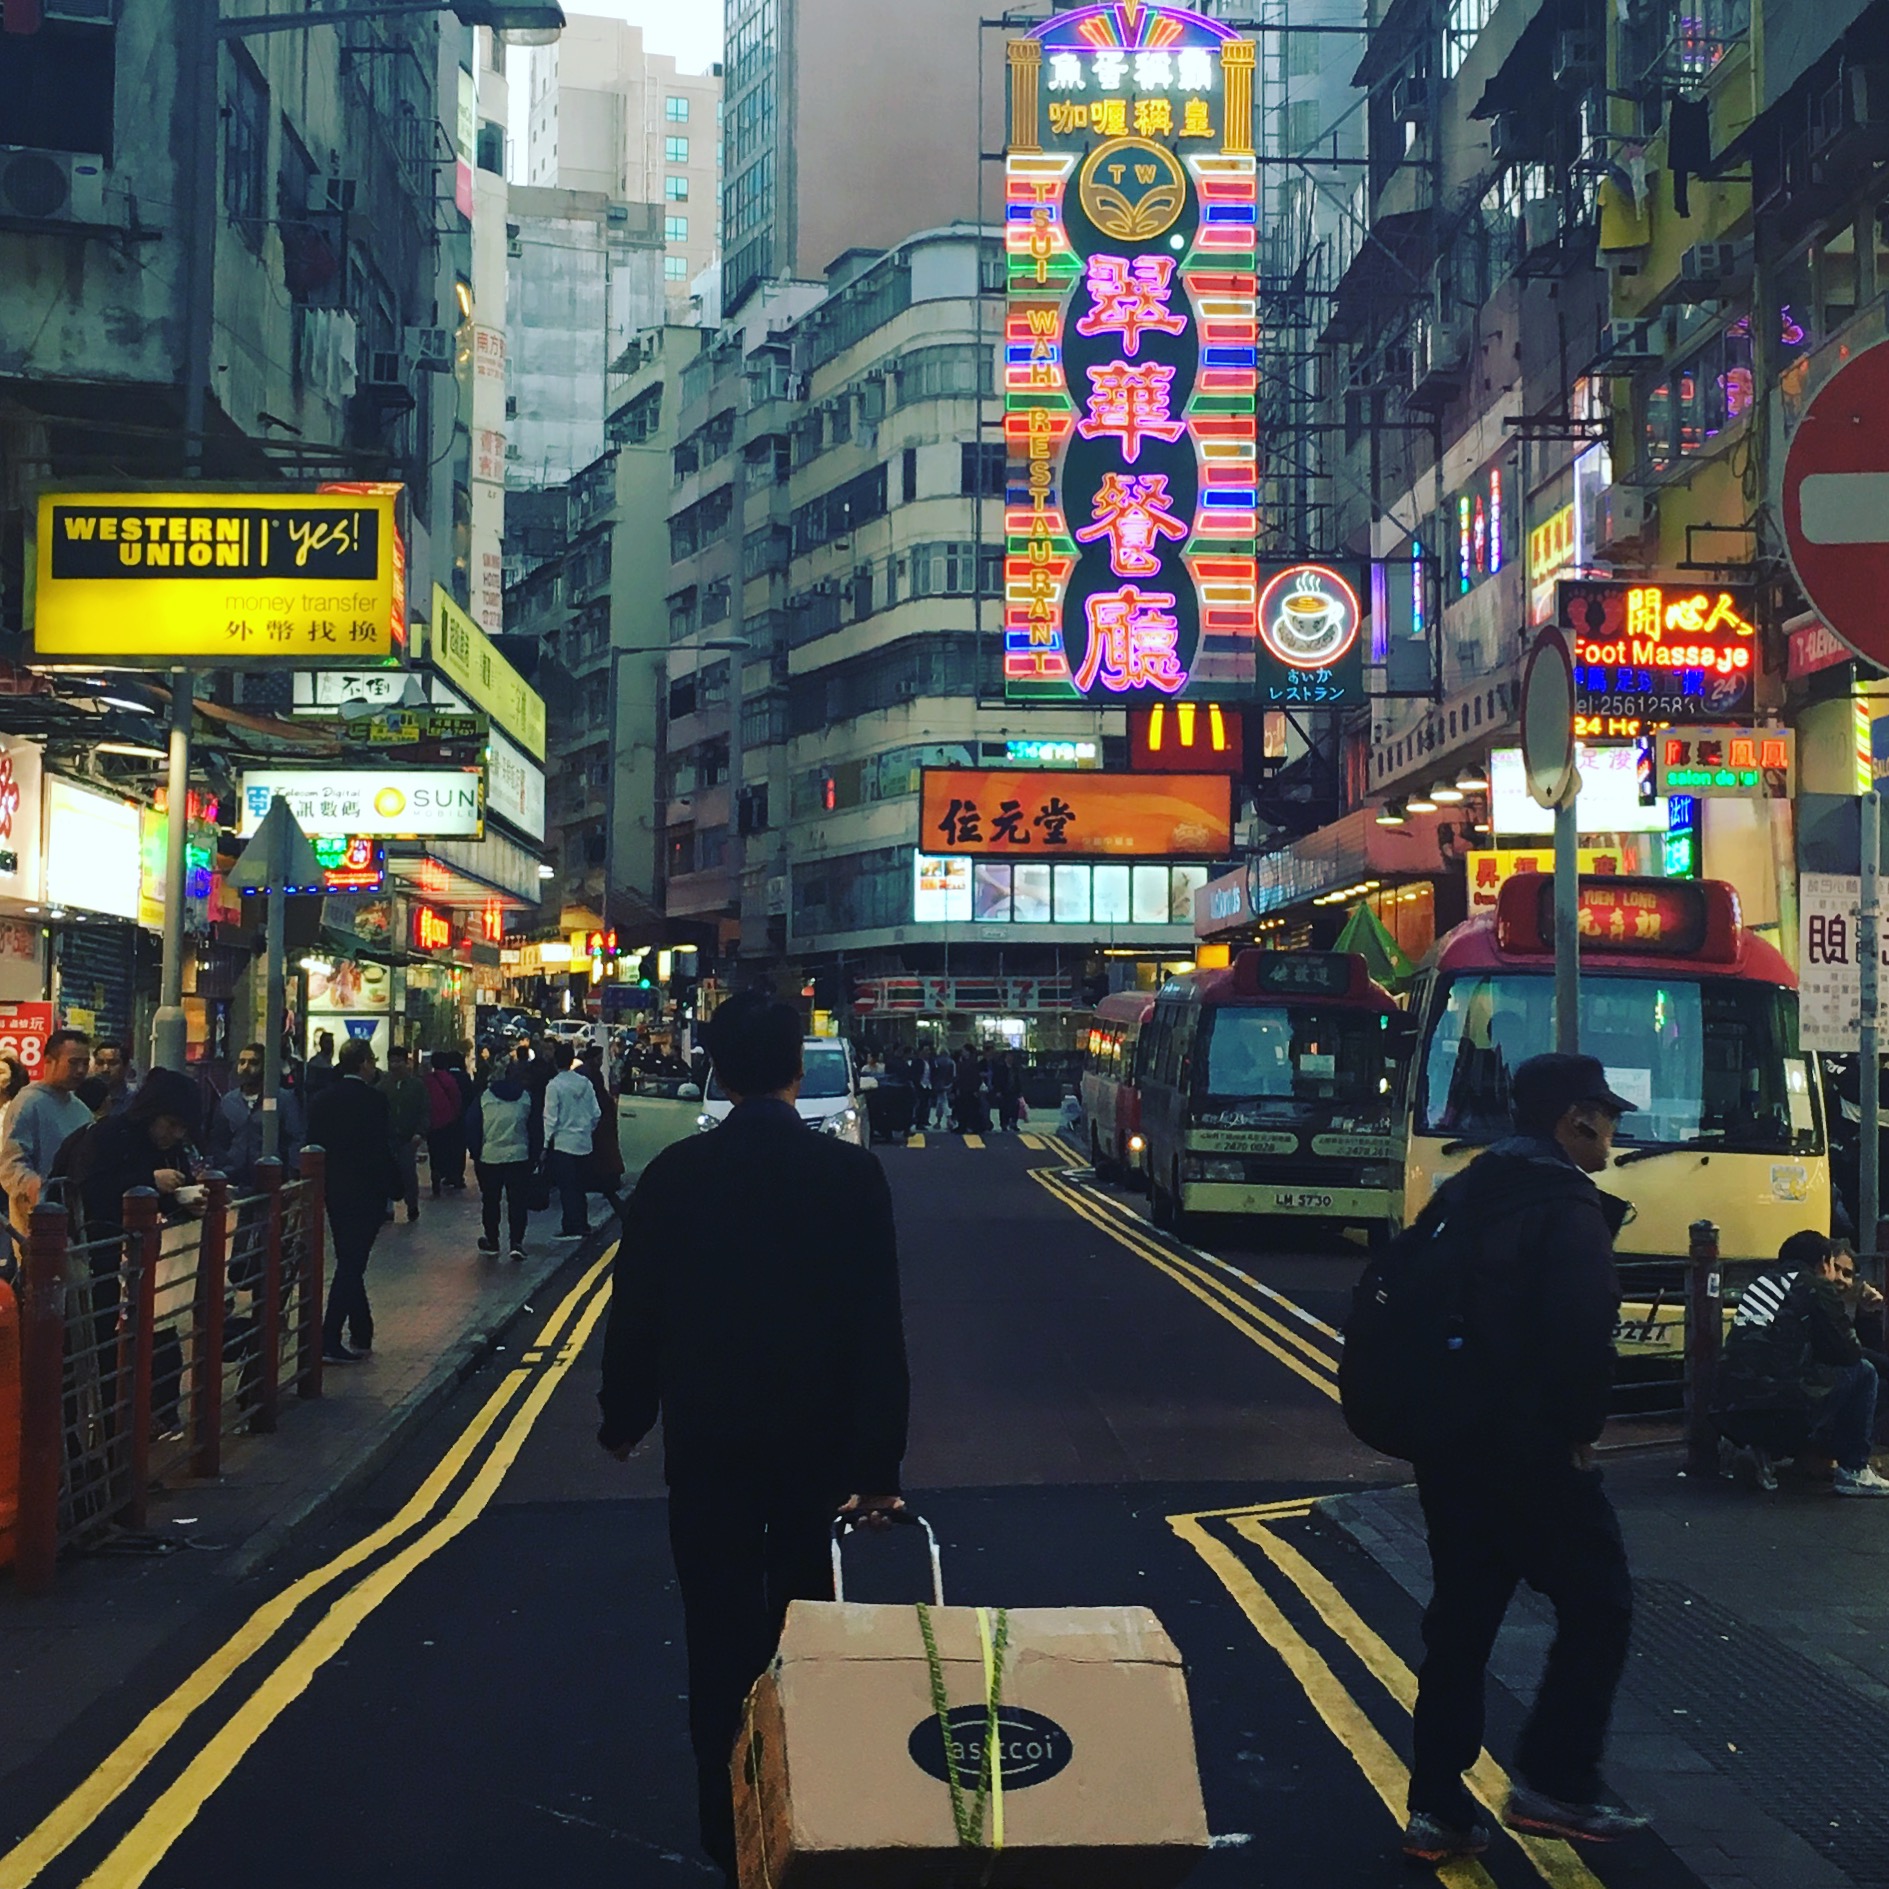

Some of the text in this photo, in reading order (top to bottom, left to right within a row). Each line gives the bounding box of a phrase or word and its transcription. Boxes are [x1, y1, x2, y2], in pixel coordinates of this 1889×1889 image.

[1028, 182, 1058, 673] TSUI WAH RESTAURANT
[1076, 254, 1188, 694] 翠華餐廳
[64, 517, 240, 541] WESTERN
[289, 512, 359, 567] yes!
[119, 543, 240, 567] UNION
[225, 593, 378, 615] money transfer
[225, 619, 378, 642] 外幣找換
[1269, 686, 1345, 701] レストラン
[1574, 717, 1602, 735] 24
[413, 789, 475, 808] SUN
[938, 797, 1076, 845] 位元堂
[1583, 890, 1656, 908] YUEN LONG
